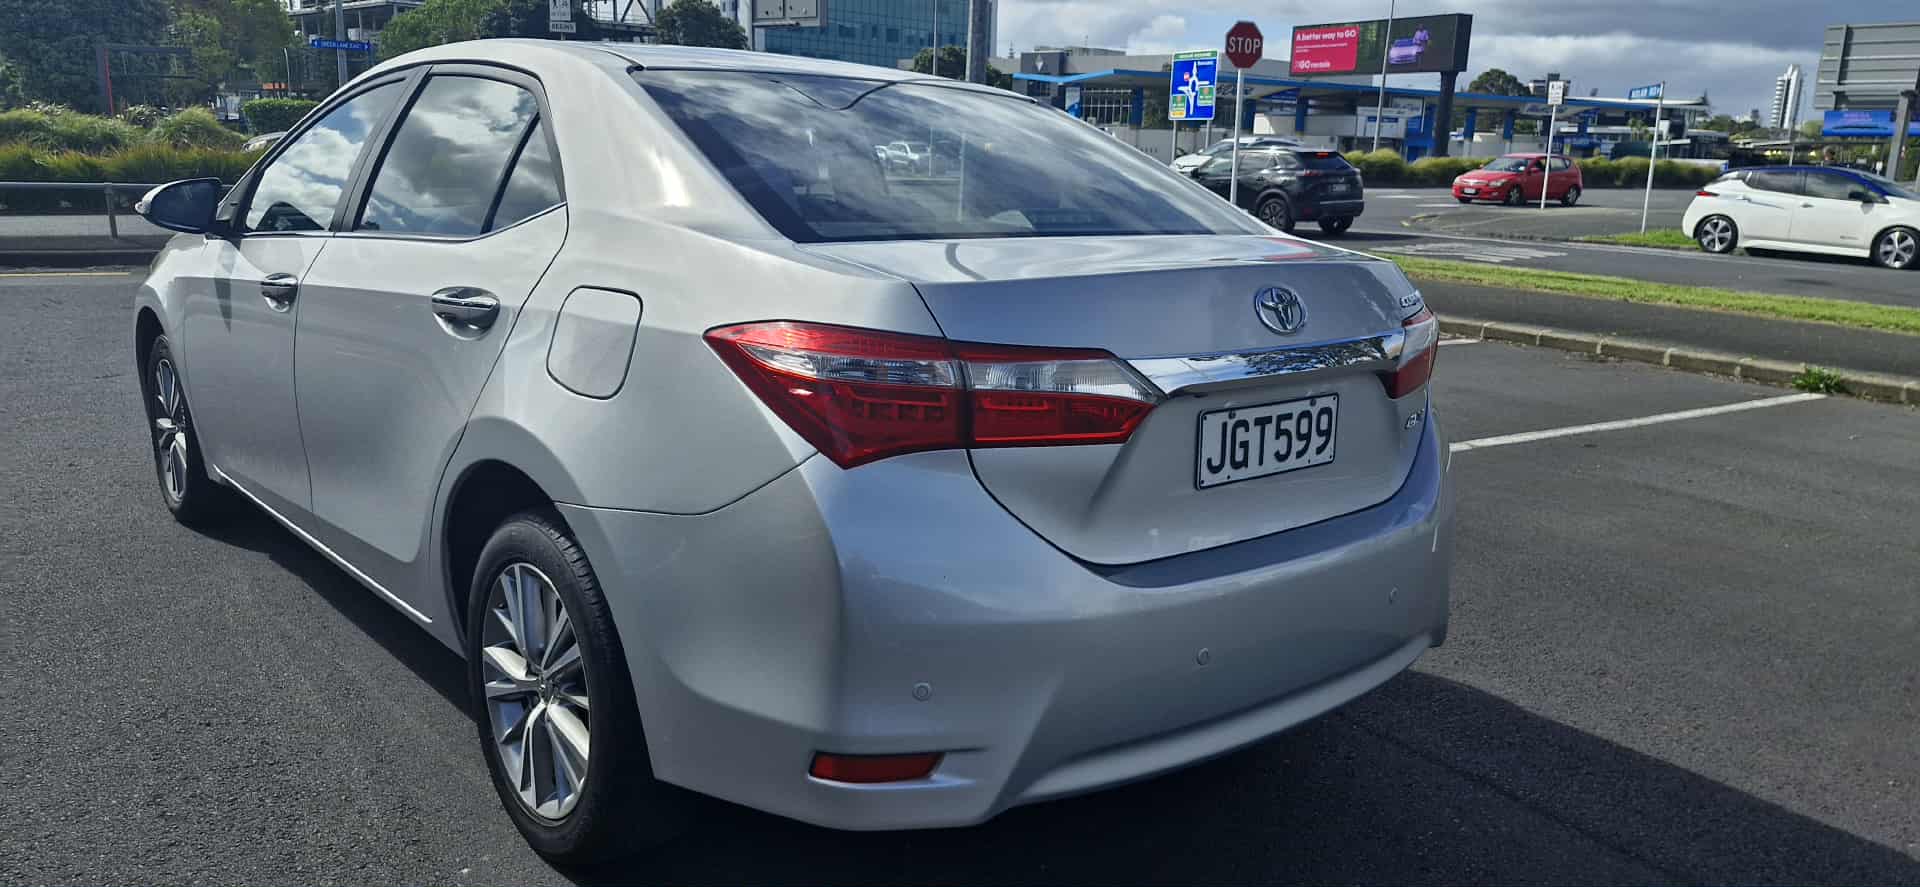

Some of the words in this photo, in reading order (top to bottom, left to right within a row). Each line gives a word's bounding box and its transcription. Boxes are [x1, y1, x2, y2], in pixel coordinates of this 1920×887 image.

[1296, 32, 1302, 40] A
[1302, 31, 1321, 40] better
[1322, 32, 1336, 40] way
[1336, 31, 1344, 39] to
[1345, 29, 1357, 38] GO
[1228, 36, 1261, 54] STOP
[1299, 60, 1310, 69] GO
[1206, 406, 1333, 474] JGT599
